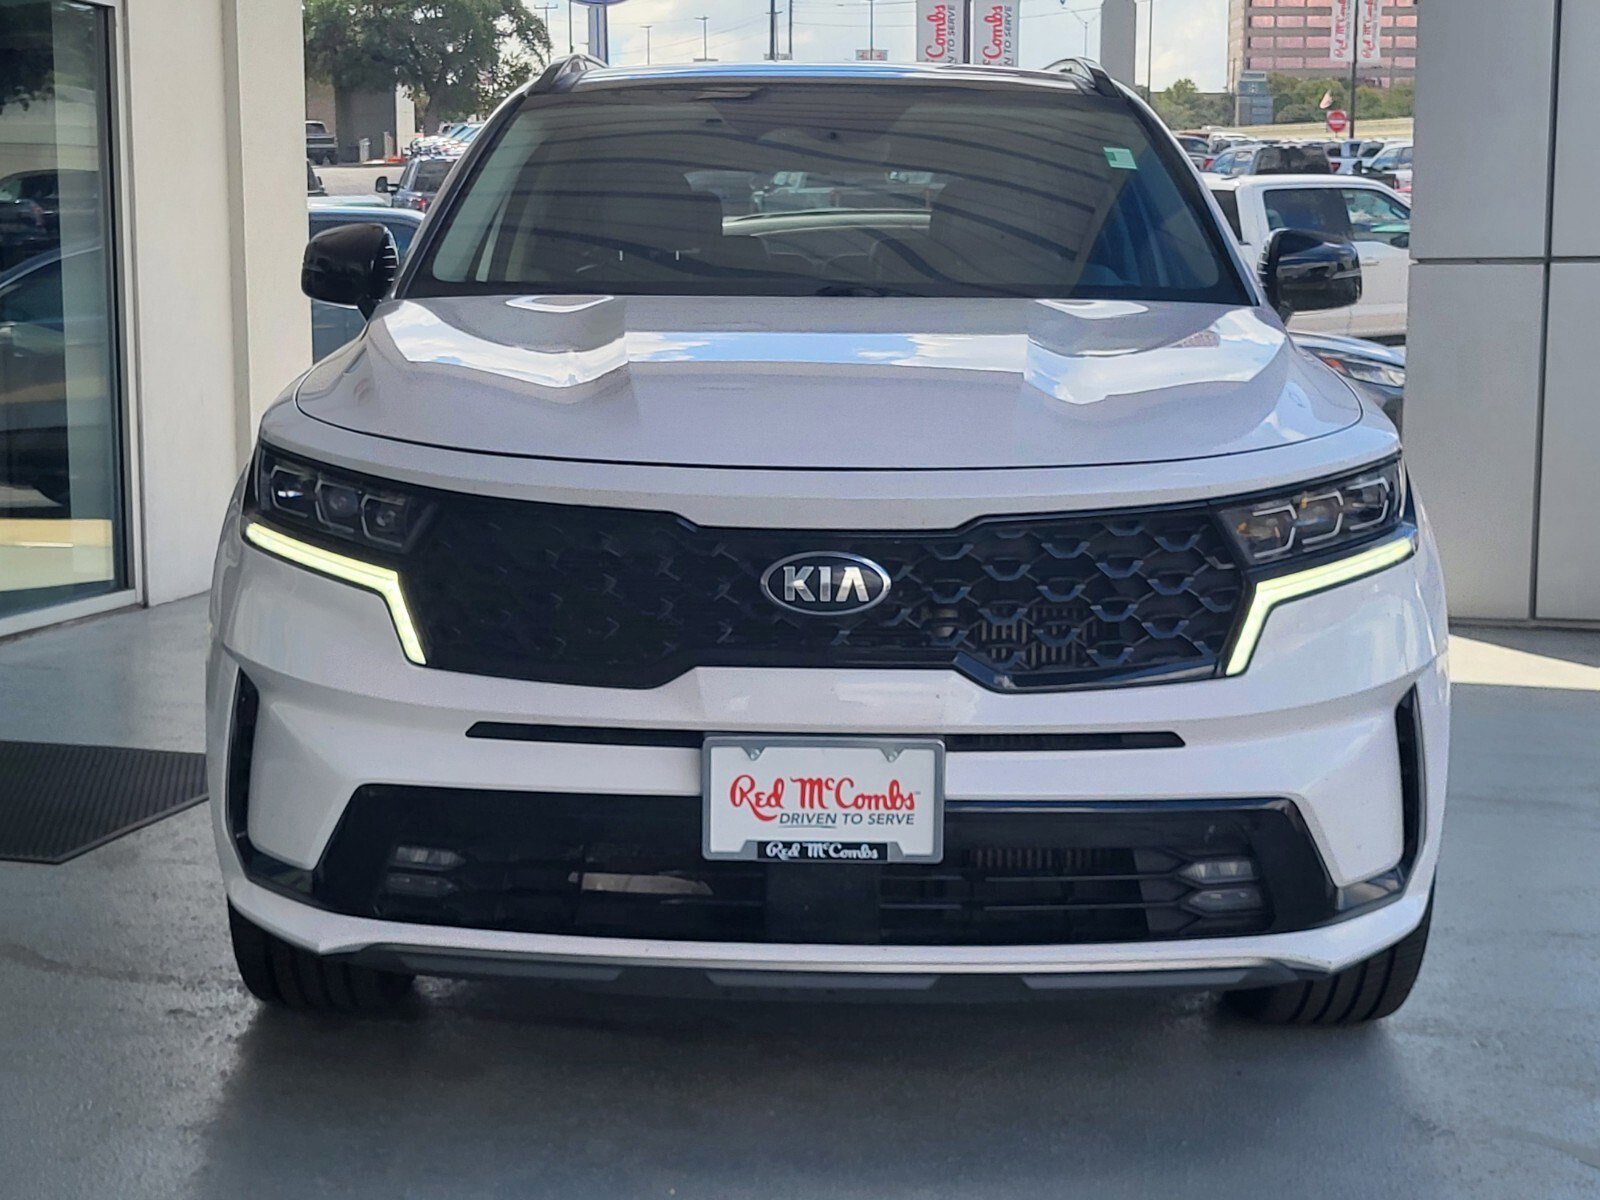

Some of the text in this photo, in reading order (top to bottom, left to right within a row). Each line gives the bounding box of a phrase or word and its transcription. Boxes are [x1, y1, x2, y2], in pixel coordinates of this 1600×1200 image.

[925, 4, 946, 62] Combs
[982, 5, 1003, 65] cCombs
[1004, 5, 1012, 37] SERVE
[948, 38, 955, 53] TO
[1004, 40, 1011, 54] TO
[783, 566, 869, 602] KIA
[730, 775, 915, 822] Red McCombs
[779, 813, 915, 826] DRIVEN TO SERVE
[766, 842, 878, 860] Red McCombs
